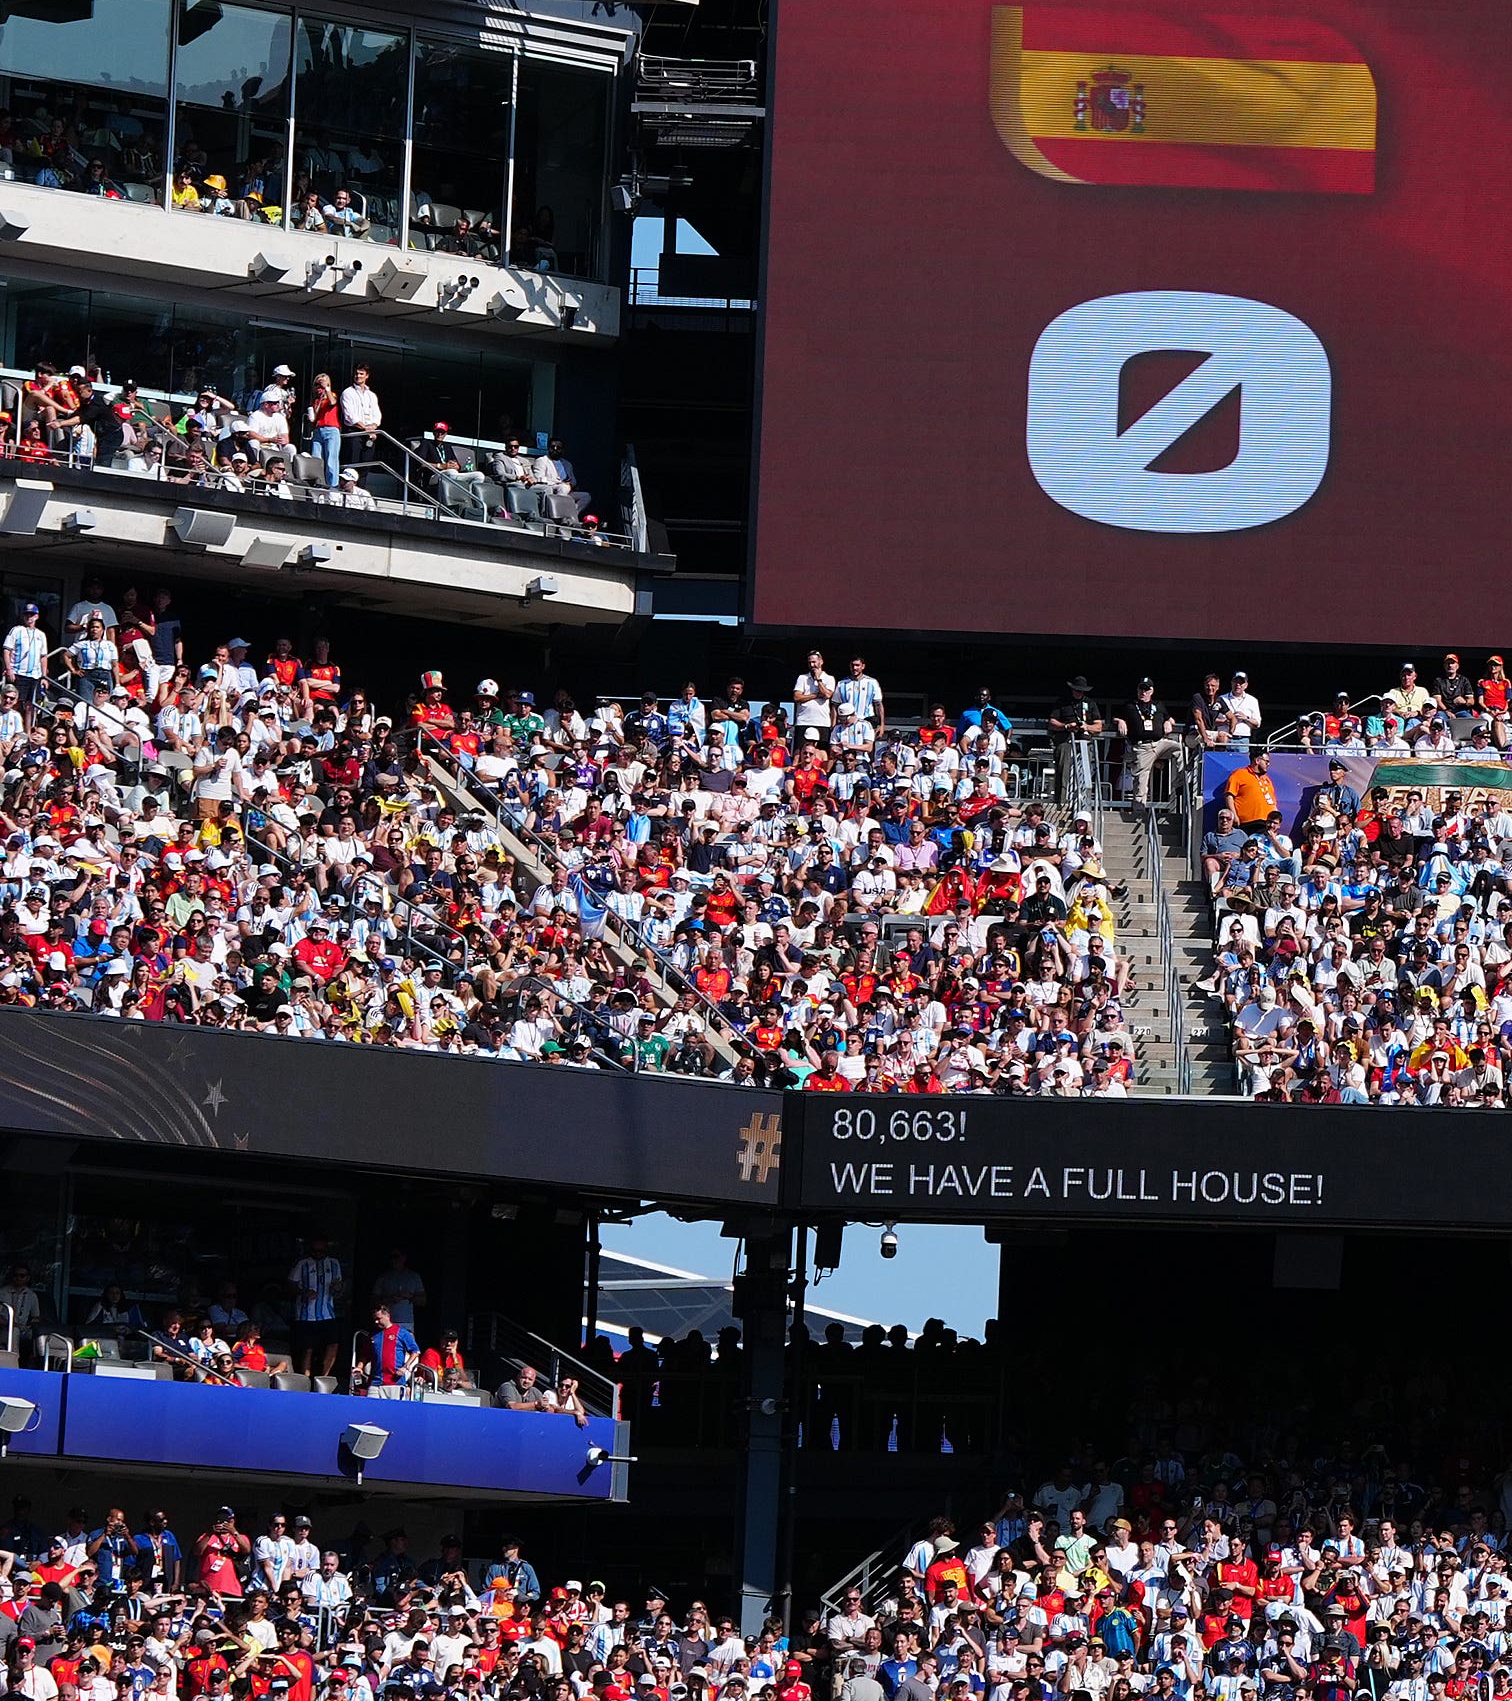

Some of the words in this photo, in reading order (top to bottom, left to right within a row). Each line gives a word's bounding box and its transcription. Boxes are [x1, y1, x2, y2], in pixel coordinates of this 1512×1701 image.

[1026, 290, 1332, 534] 0
[863, 887, 887, 895] USA
[832, 1108, 966, 1145] 80,663!
[830, 1162, 894, 1194] WE
[909, 1164, 1014, 1197] HAVE
[1023, 1166, 1051, 1198] A
[1063, 1167, 1159, 1201] FULL
[1172, 1170, 1323, 1205] HOUSE!
